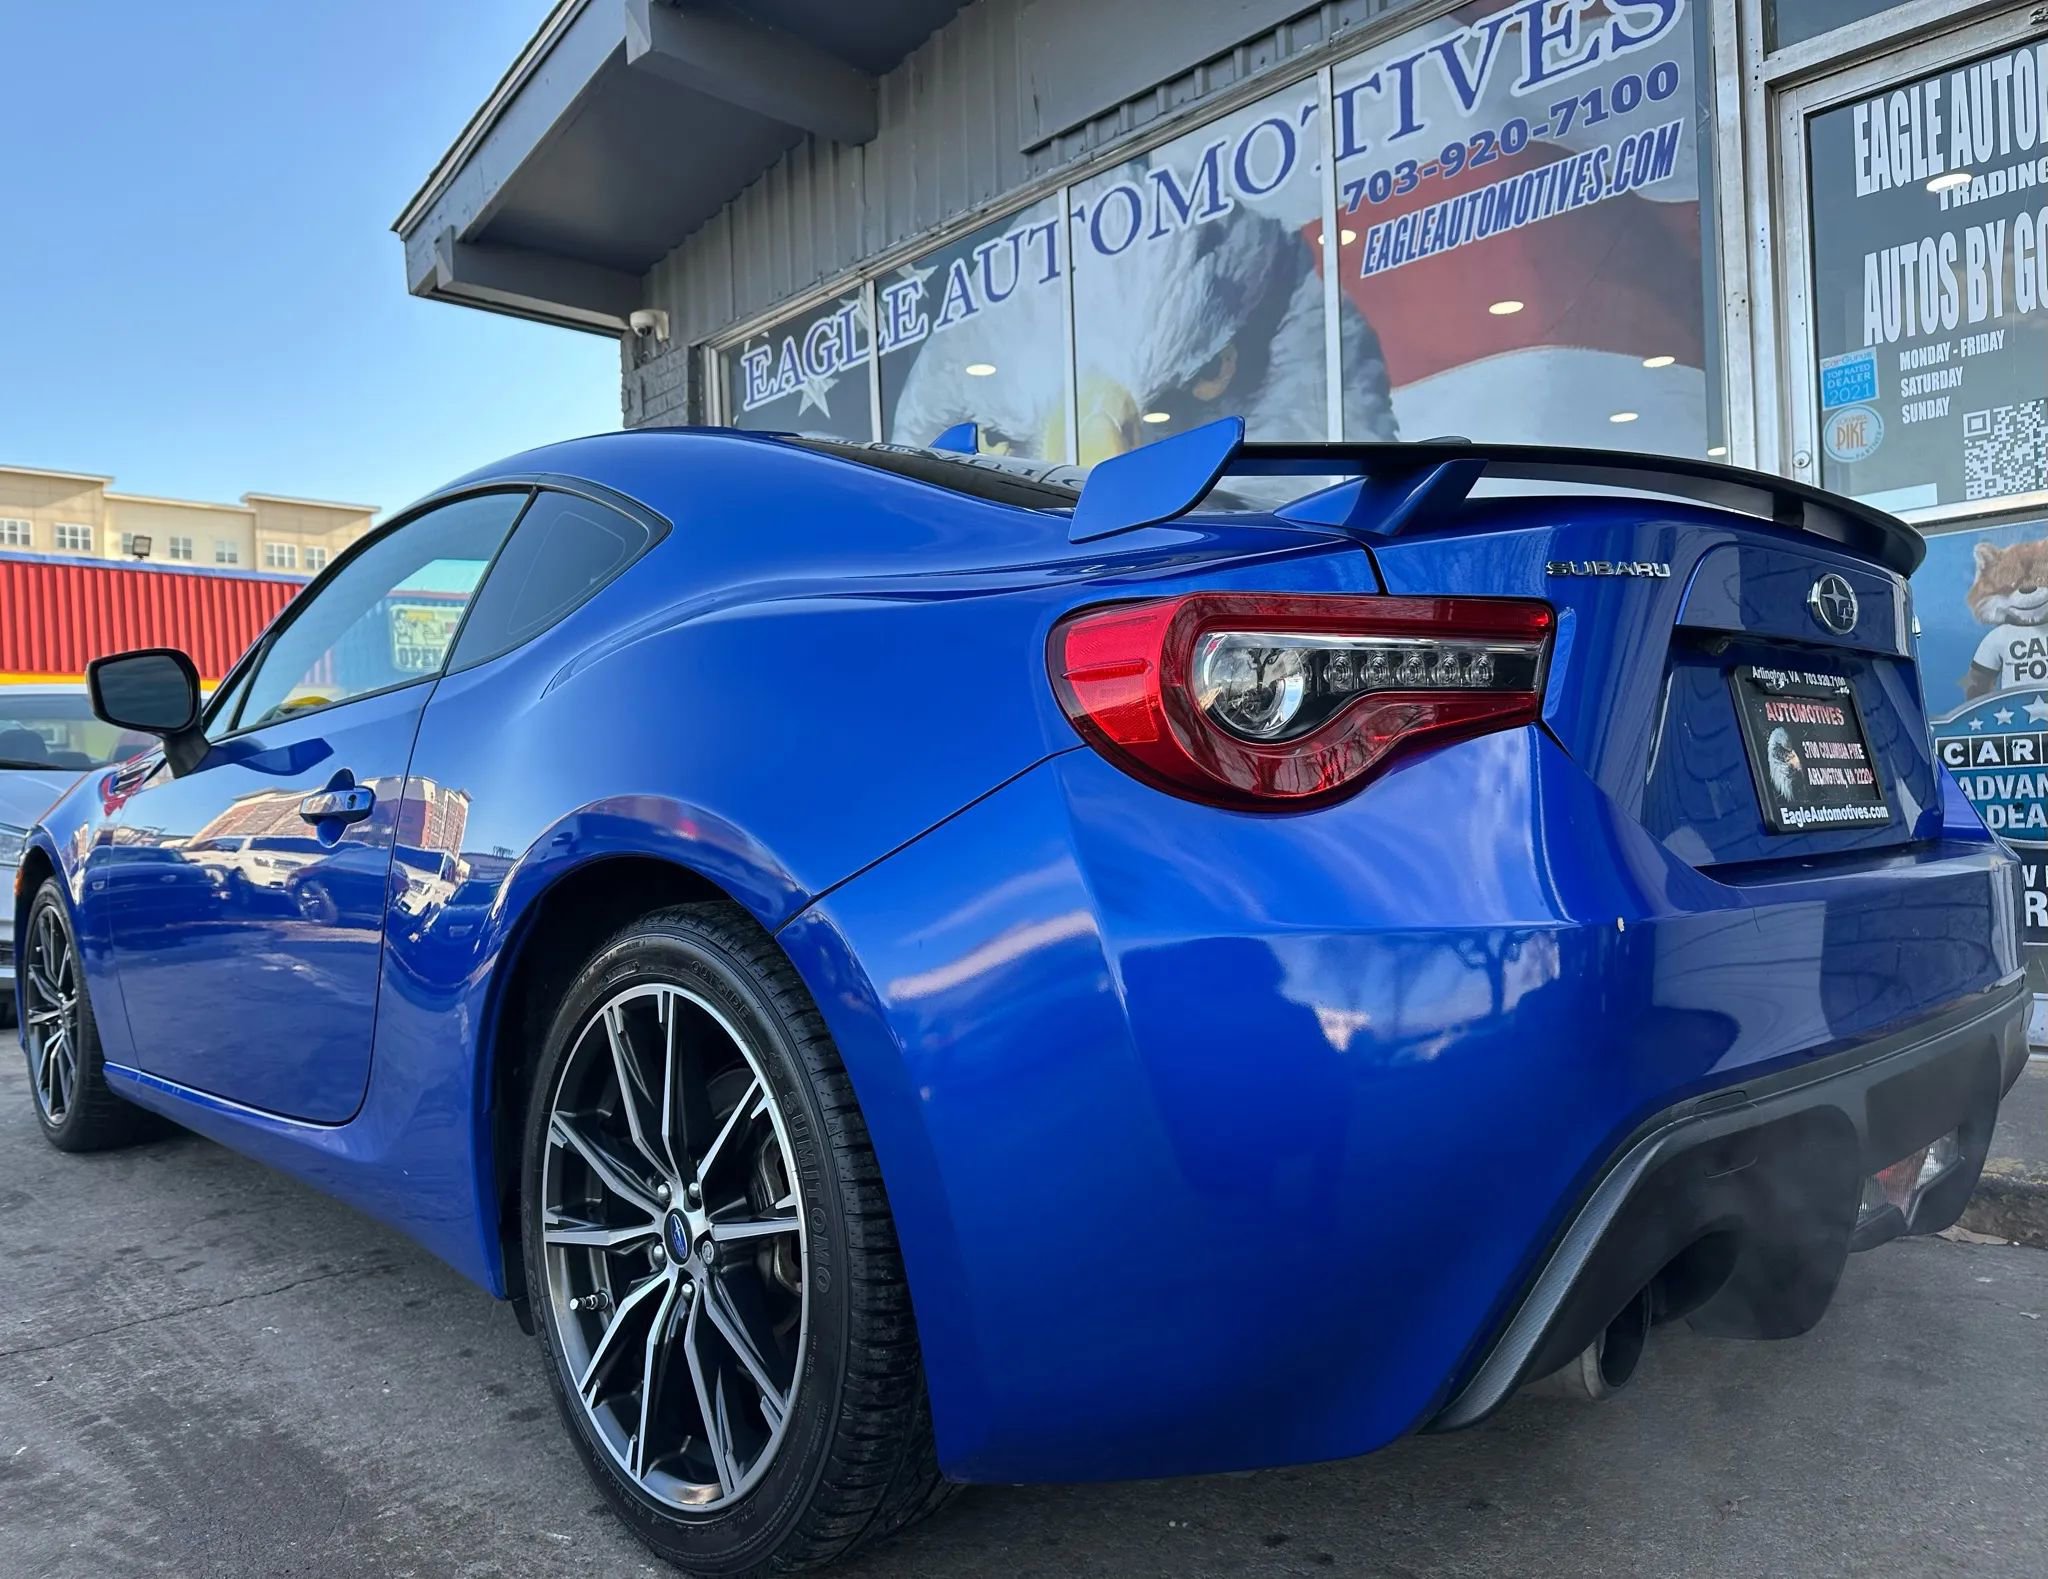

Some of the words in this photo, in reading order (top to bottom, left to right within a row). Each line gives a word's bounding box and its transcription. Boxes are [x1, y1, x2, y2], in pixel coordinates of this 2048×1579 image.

[1344, 61, 1679, 214] 703-920-7100
[1854, 79, 1944, 198] EAGLE
[744, 281, 926, 408] EAGLE
[935, 0, 1684, 334] AUTOMOTIVES
[1361, 119, 1684, 278] EAGLEAUTOMOTIVES.COM
[1863, 232, 1959, 346] AUTOS
[1965, 219, 2006, 323] BY
[1900, 342, 1950, 371] MONDAY
[1960, 329, 2005, 358] FRIDAY
[1827, 370, 1844, 380] TOP
[1844, 363, 1871, 376] RATED
[1827, 372, 1872, 389] DEALER
[1900, 366, 1963, 398] SATURDAY
[1828, 382, 1872, 405] 2021
[1902, 396, 1950, 424] SUNDAY
[1835, 420, 1868, 450] PIKE
[1546, 560, 1671, 577] SUBARU
[2009, 637, 2048, 660] CA
[1788, 670, 1801, 683] VA
[2014, 659, 2048, 681] FO
[1765, 702, 1845, 725] AUTOMOTIVES
[1847, 743, 1865, 760] PIKE
[1780, 803, 1889, 828] EagleAutomotives.com
[690, 960, 751, 1018] OUTSIDE
[783, 1090, 831, 1293] SUMITOMO
